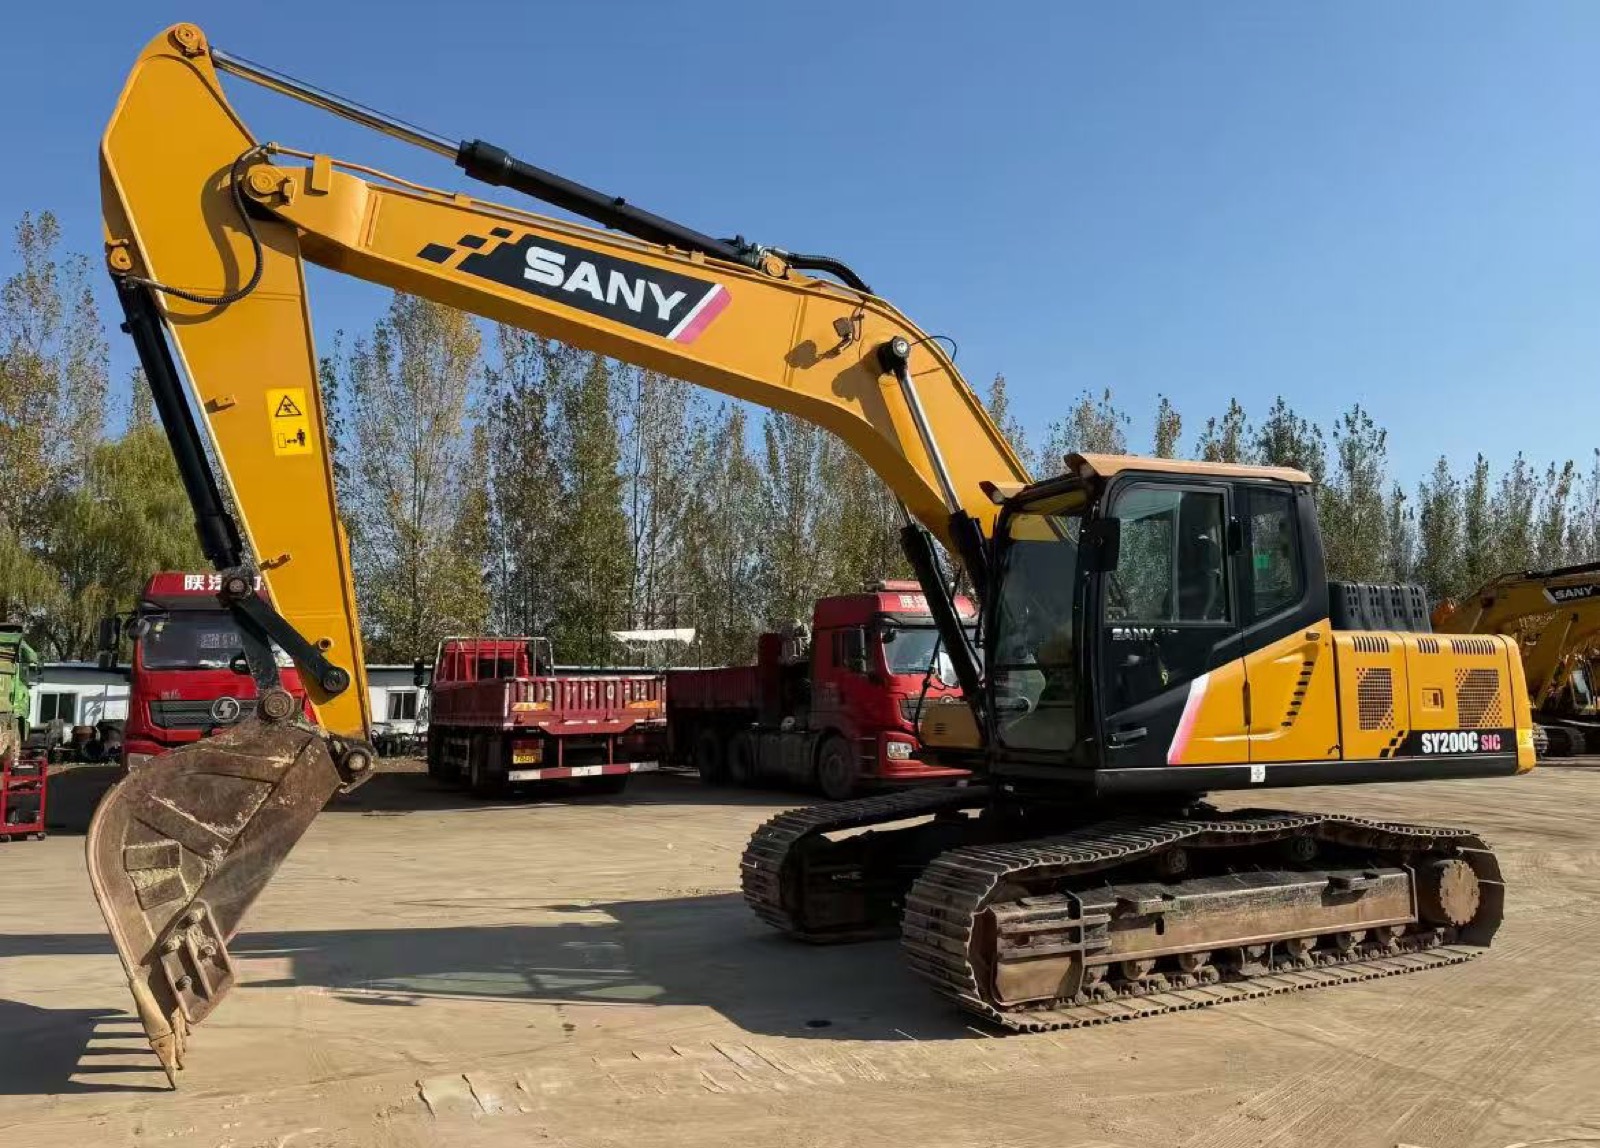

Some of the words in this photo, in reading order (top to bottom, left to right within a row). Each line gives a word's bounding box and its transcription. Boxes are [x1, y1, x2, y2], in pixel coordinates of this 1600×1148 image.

[523, 246, 688, 321] SANY
[1555, 585, 1593, 600] SANY
[1421, 731, 1479, 754] SY200C
[1480, 733, 1501, 751] SIC
